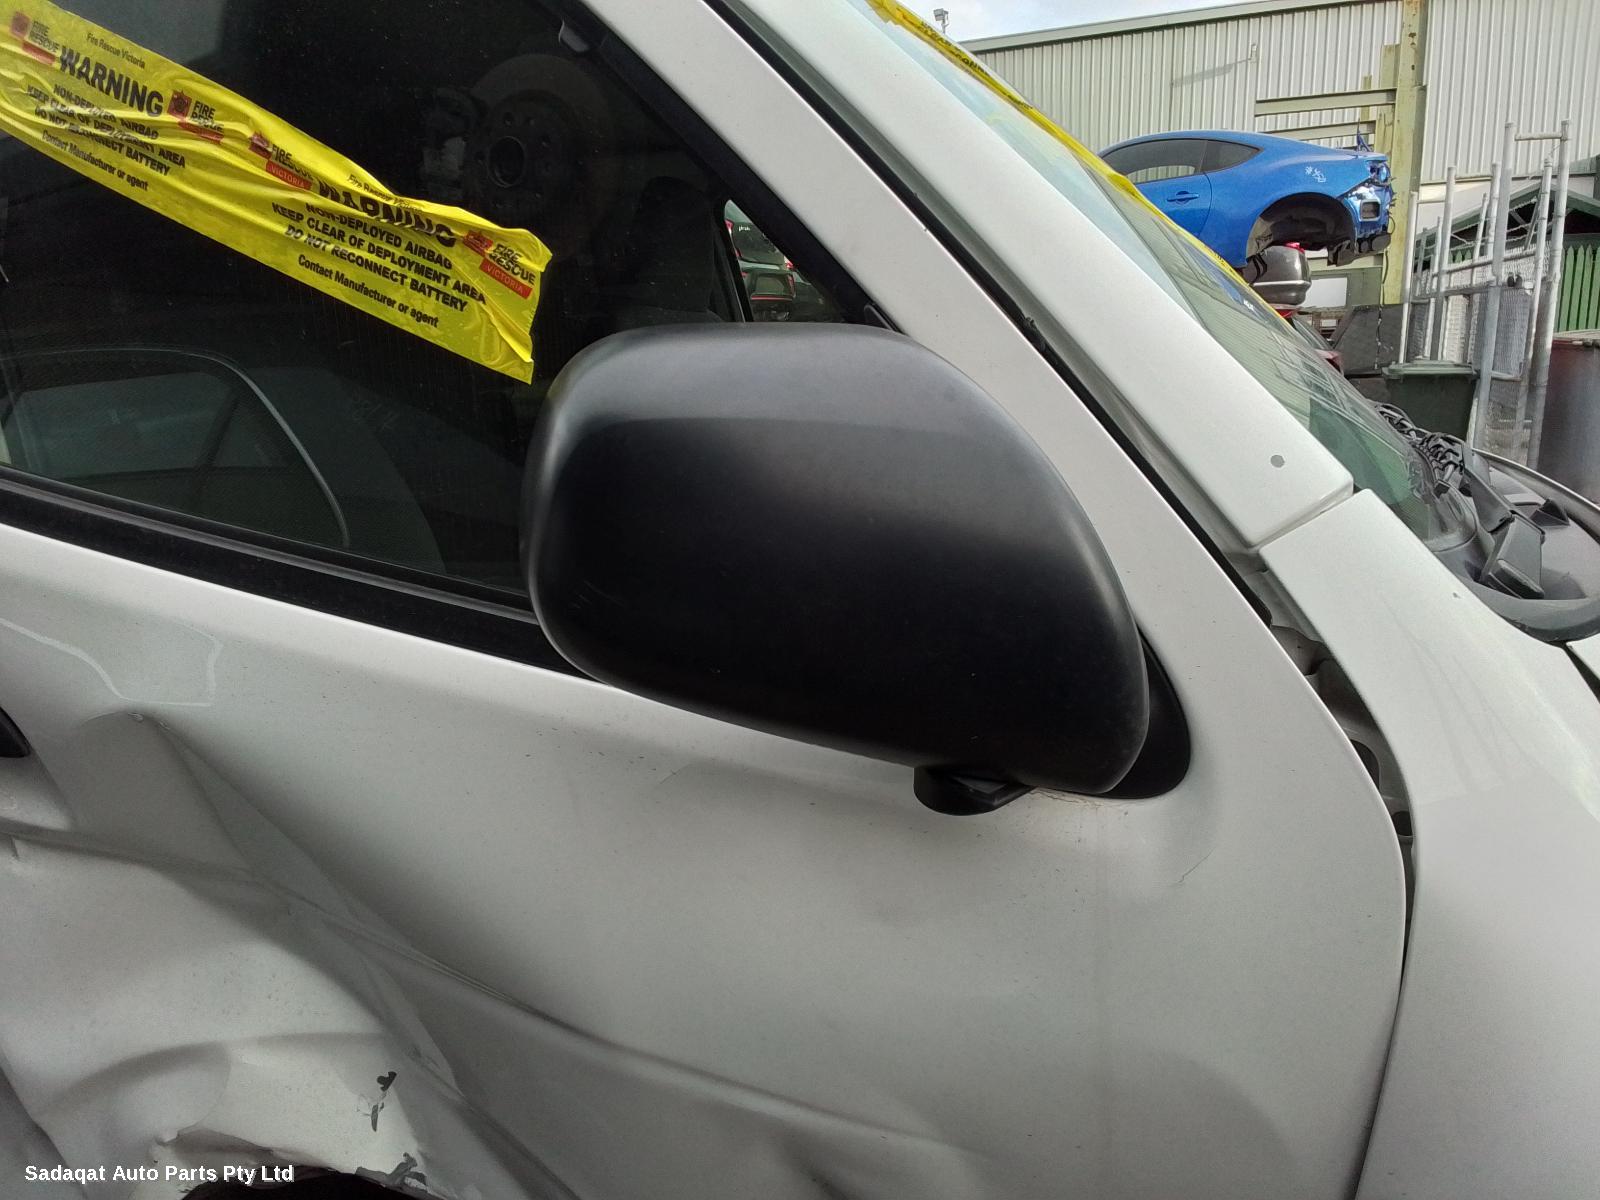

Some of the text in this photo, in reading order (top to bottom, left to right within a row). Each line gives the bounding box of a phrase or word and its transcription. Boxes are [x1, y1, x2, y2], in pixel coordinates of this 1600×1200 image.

[86, 32, 146, 69] Fire Rescue Victoria
[60, 45, 164, 117] WARNING
[193, 100, 216, 119] FIRE
[69, 142, 117, 175] Manufacturer
[117, 168, 126, 179] or
[126, 173, 149, 192] agent
[125, 146, 171, 176] BATTERY
[158, 147, 186, 168] AREA
[272, 143, 293, 161] FIRE
[270, 164, 306, 189] VICTORIA
[272, 202, 487, 305] KEEP CLEAR OF DEPLOYMENT AREA
[284, 224, 469, 312] DO NOT RECONNECT BATTERY
[404, 240, 453, 270] AIRBAG
[487, 252, 537, 286] RESCUE
[492, 242, 523, 264] FIRE
[298, 254, 439, 328] Contact Manufacturer or agent
[486, 263, 525, 295] VICTORIA
